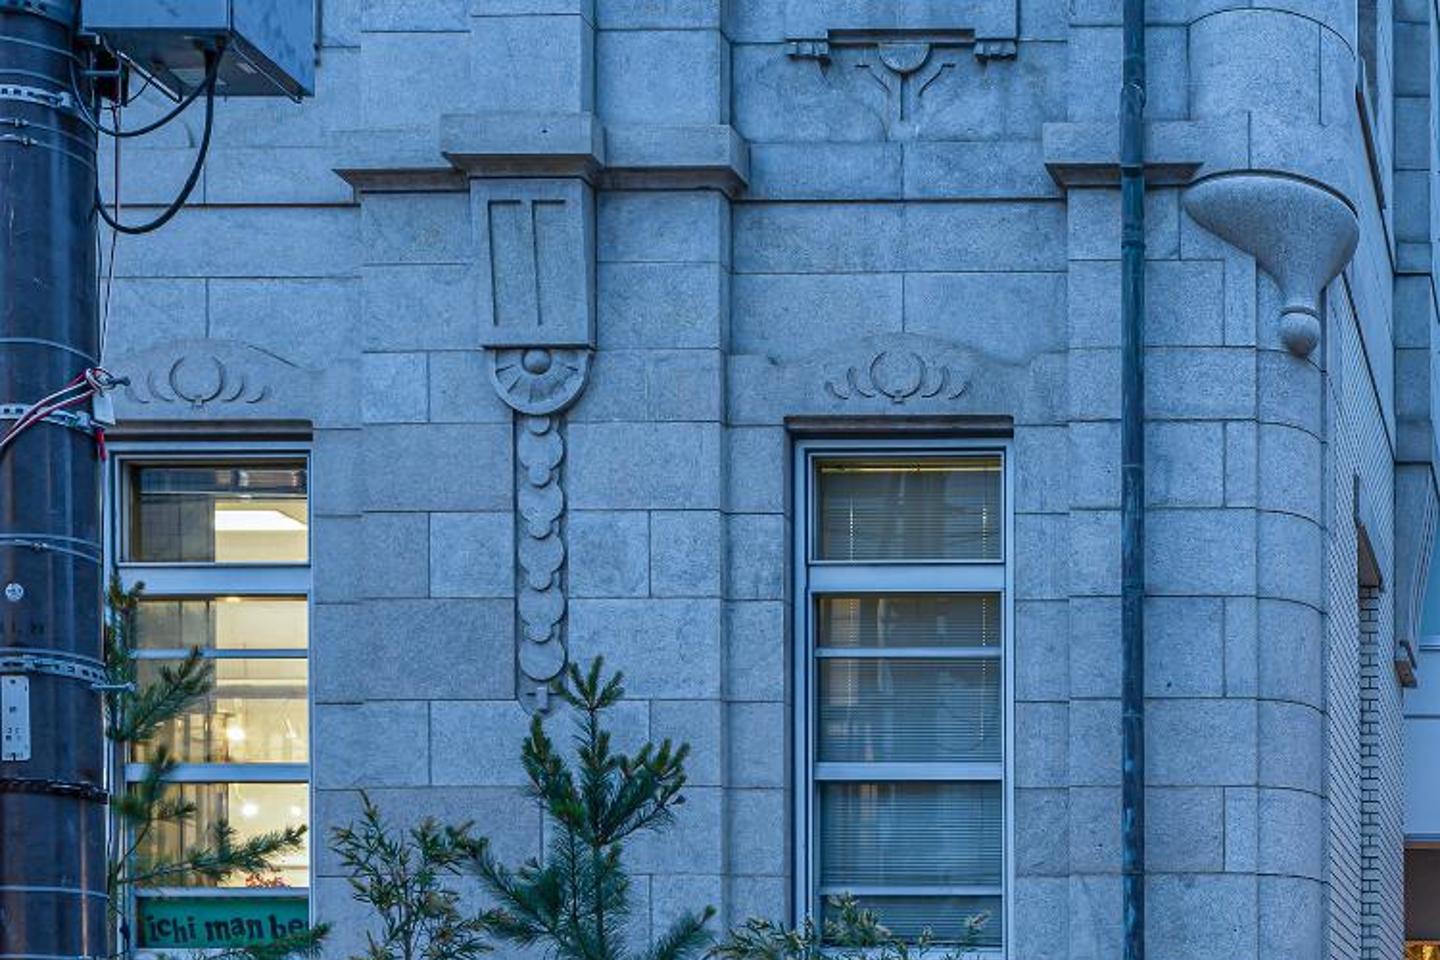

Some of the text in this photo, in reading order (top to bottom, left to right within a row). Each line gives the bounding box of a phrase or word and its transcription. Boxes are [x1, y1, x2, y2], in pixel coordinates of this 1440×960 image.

[146, 913, 309, 943] ichi man be
